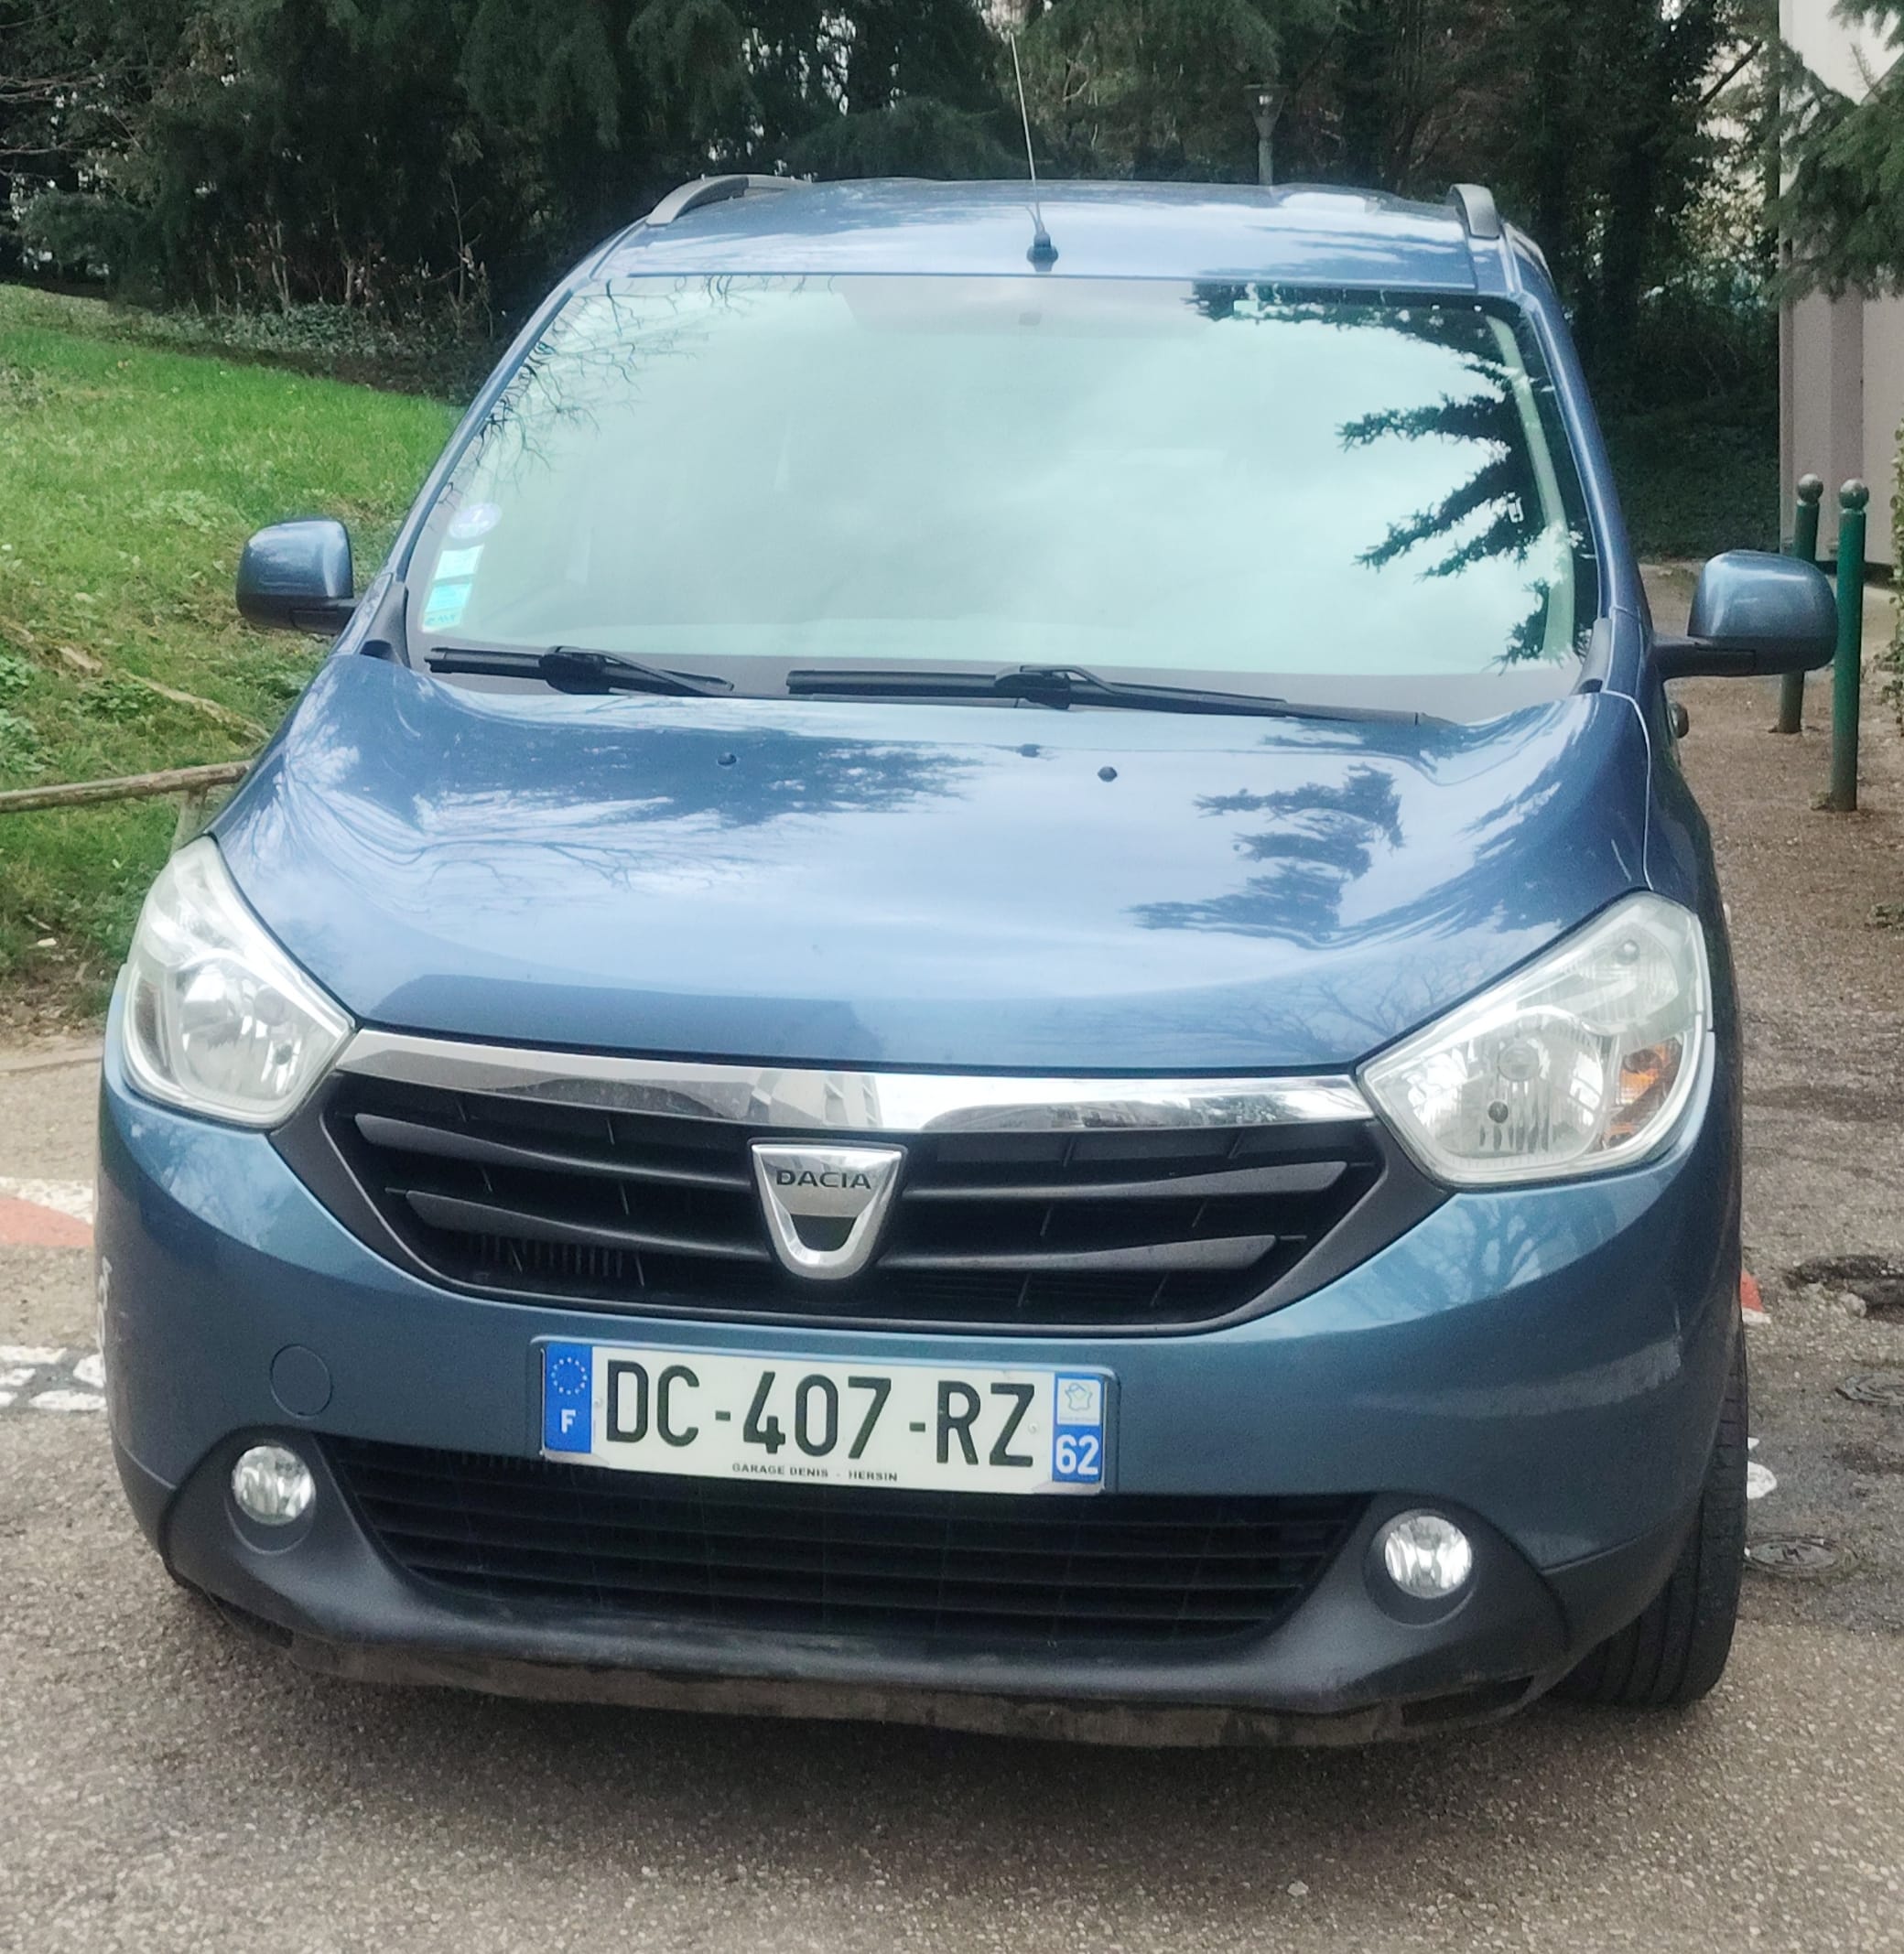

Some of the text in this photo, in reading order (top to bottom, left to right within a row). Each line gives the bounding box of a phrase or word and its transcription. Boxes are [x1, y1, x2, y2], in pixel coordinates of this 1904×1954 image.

[776, 1170, 872, 1190] DACIA
[561, 1409, 576, 1434] F
[1055, 1433, 1098, 1475] 62
[732, 1463, 784, 1475] GARAGE
[789, 1466, 828, 1478] DENIS
[849, 1470, 897, 1482] HERSIN
